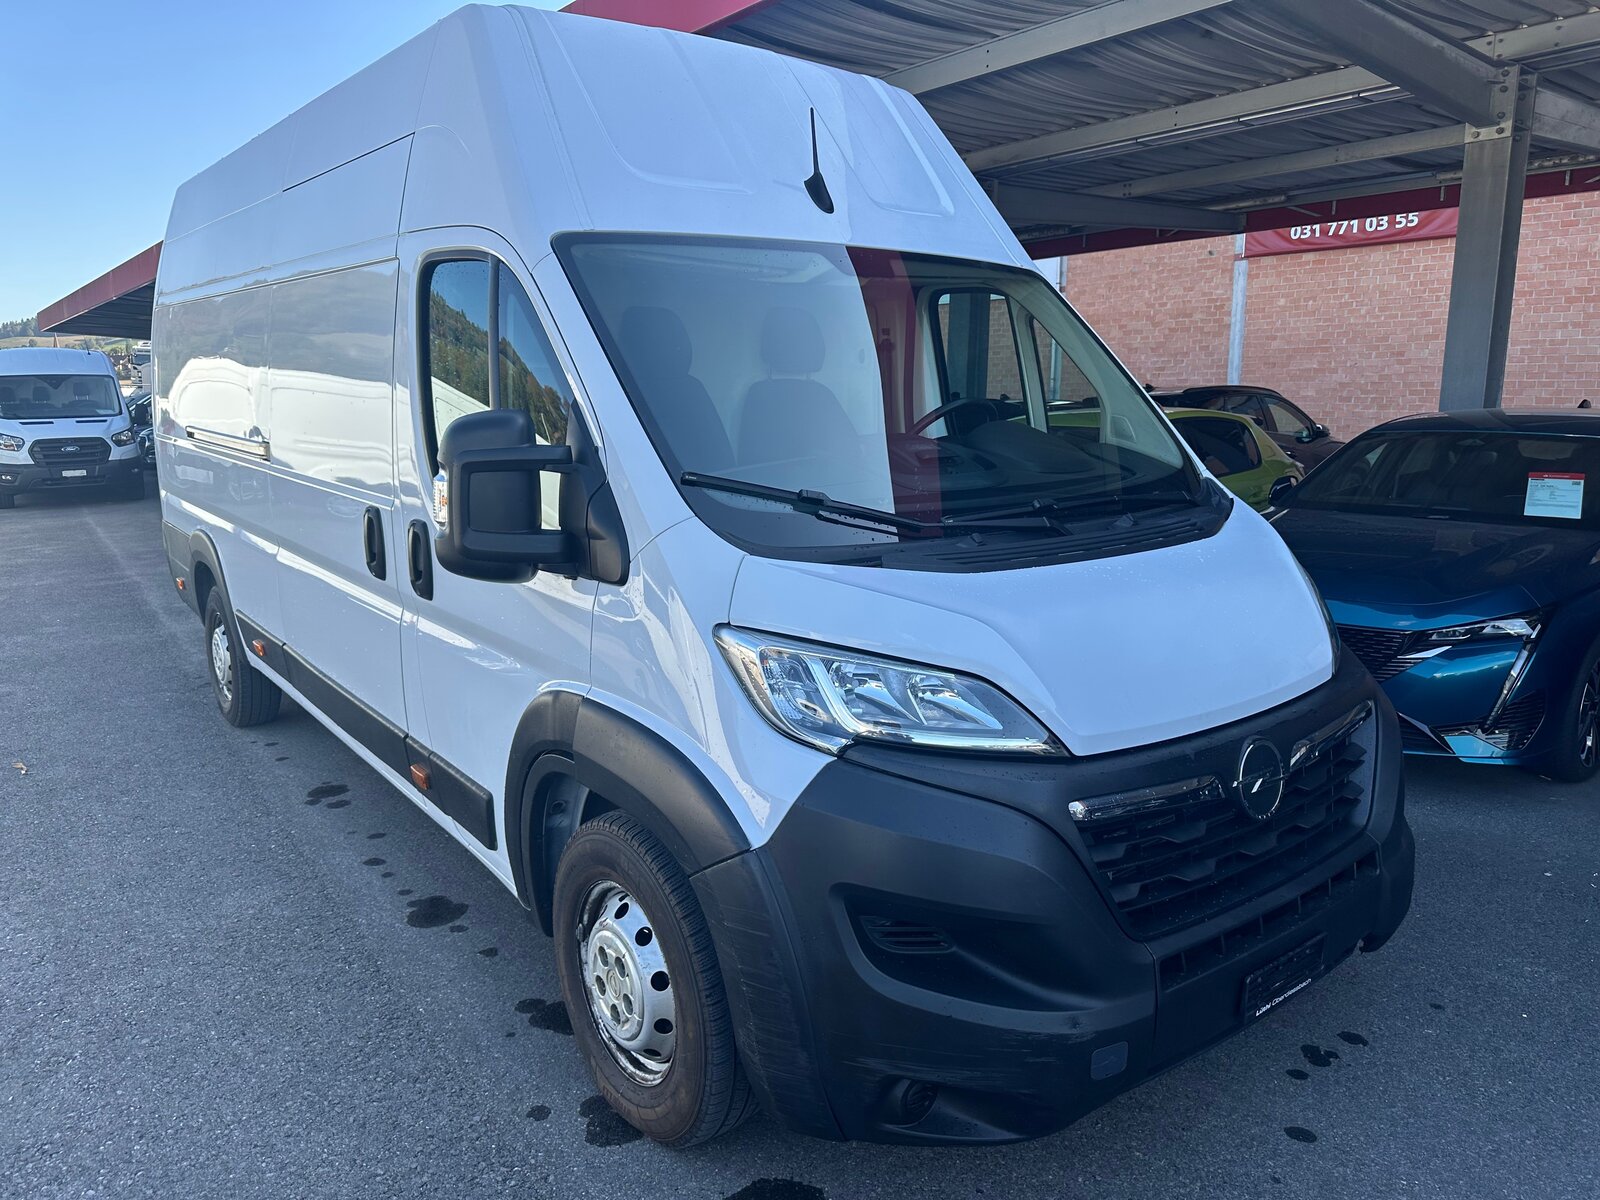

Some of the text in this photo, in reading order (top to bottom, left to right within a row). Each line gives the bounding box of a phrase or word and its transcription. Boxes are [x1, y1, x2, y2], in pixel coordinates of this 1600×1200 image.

[1290, 212, 1419, 240] 031 771 03 55
